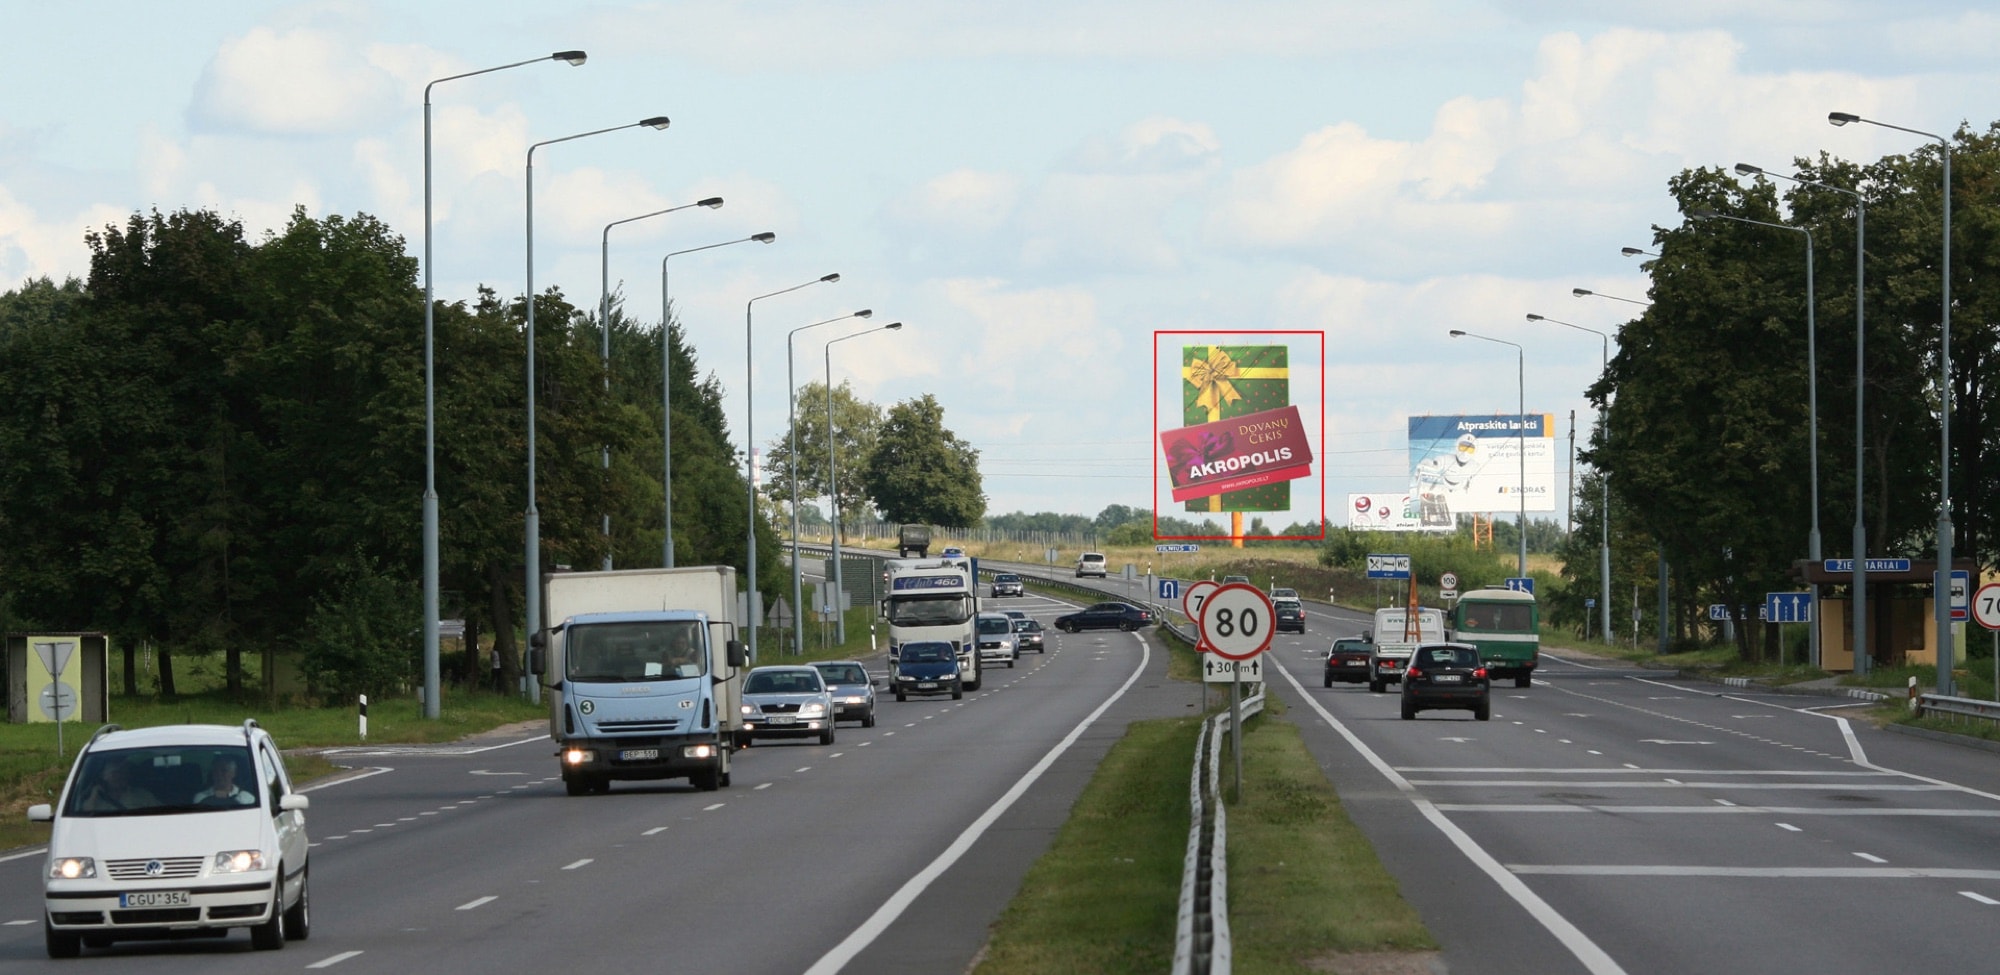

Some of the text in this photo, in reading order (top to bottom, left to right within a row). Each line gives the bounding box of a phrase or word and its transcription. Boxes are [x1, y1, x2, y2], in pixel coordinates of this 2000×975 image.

[1239, 418, 1289, 436] DOVANŲ
[1457, 420, 1537, 433] Atpraskite lakti
[1249, 430, 1282, 444] ČEKIS
[1190, 447, 1292, 479] AKROPOLIS
[1398, 560, 1408, 568] WC
[934, 578, 959, 586] 460
[1443, 577, 1455, 585] 100
[1216, 608, 1258, 637] 80
[583, 701, 592, 713] 3
[127, 893, 189, 906] CGU 354
